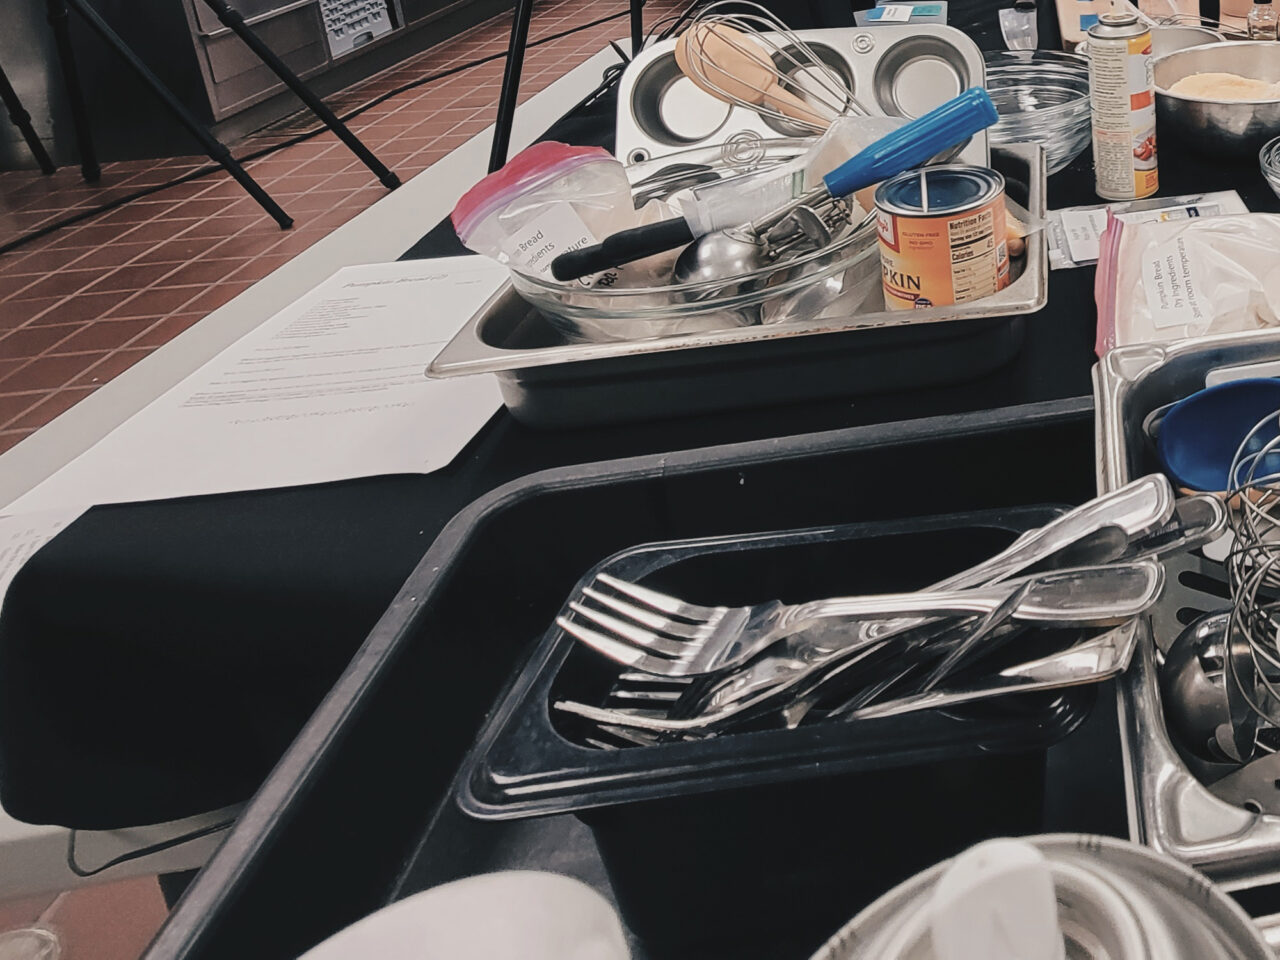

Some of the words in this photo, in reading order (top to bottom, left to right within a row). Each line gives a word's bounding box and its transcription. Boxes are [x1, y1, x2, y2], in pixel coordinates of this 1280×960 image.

[949, 218, 977, 230] Nutrition
[518, 230, 544, 252] Bread
[952, 250, 974, 261] Calories
[1152, 260, 1163, 280] Bread
[1166, 255, 1181, 297] Ingredients
[1185, 280, 1195, 300] room
[1174, 298, 1184, 308] Dry
